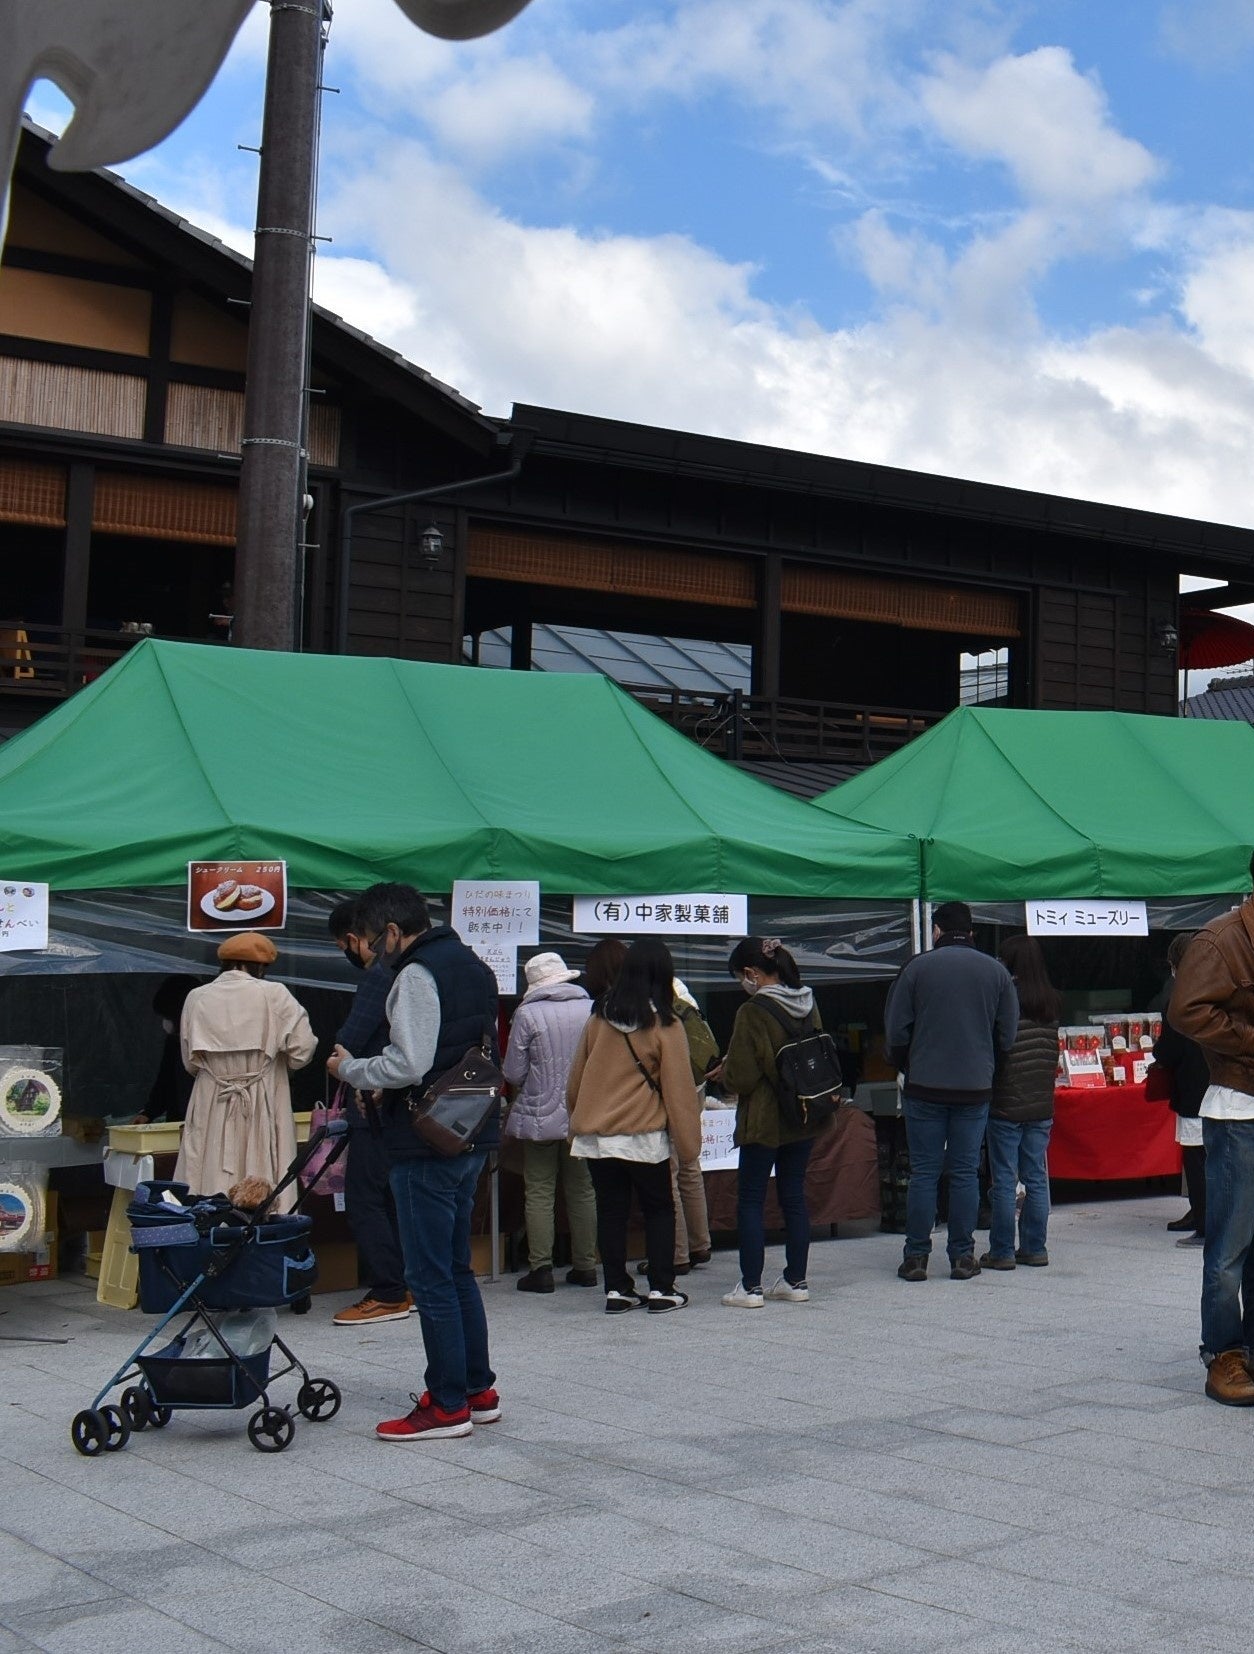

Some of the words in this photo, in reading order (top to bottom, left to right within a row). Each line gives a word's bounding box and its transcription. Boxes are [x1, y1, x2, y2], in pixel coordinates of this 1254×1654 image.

[195, 866, 243, 874] シュークリーム
[465, 890, 531, 899] ひだの味まつり
[462, 906, 532, 918] 特別価格にて
[594, 902, 729, 924] （有）中家製菓舗
[1036, 910, 1067, 925] トミィ
[1075, 910, 1140, 926] ミューズリー
[701, 1134, 733, 1144] 格にて
